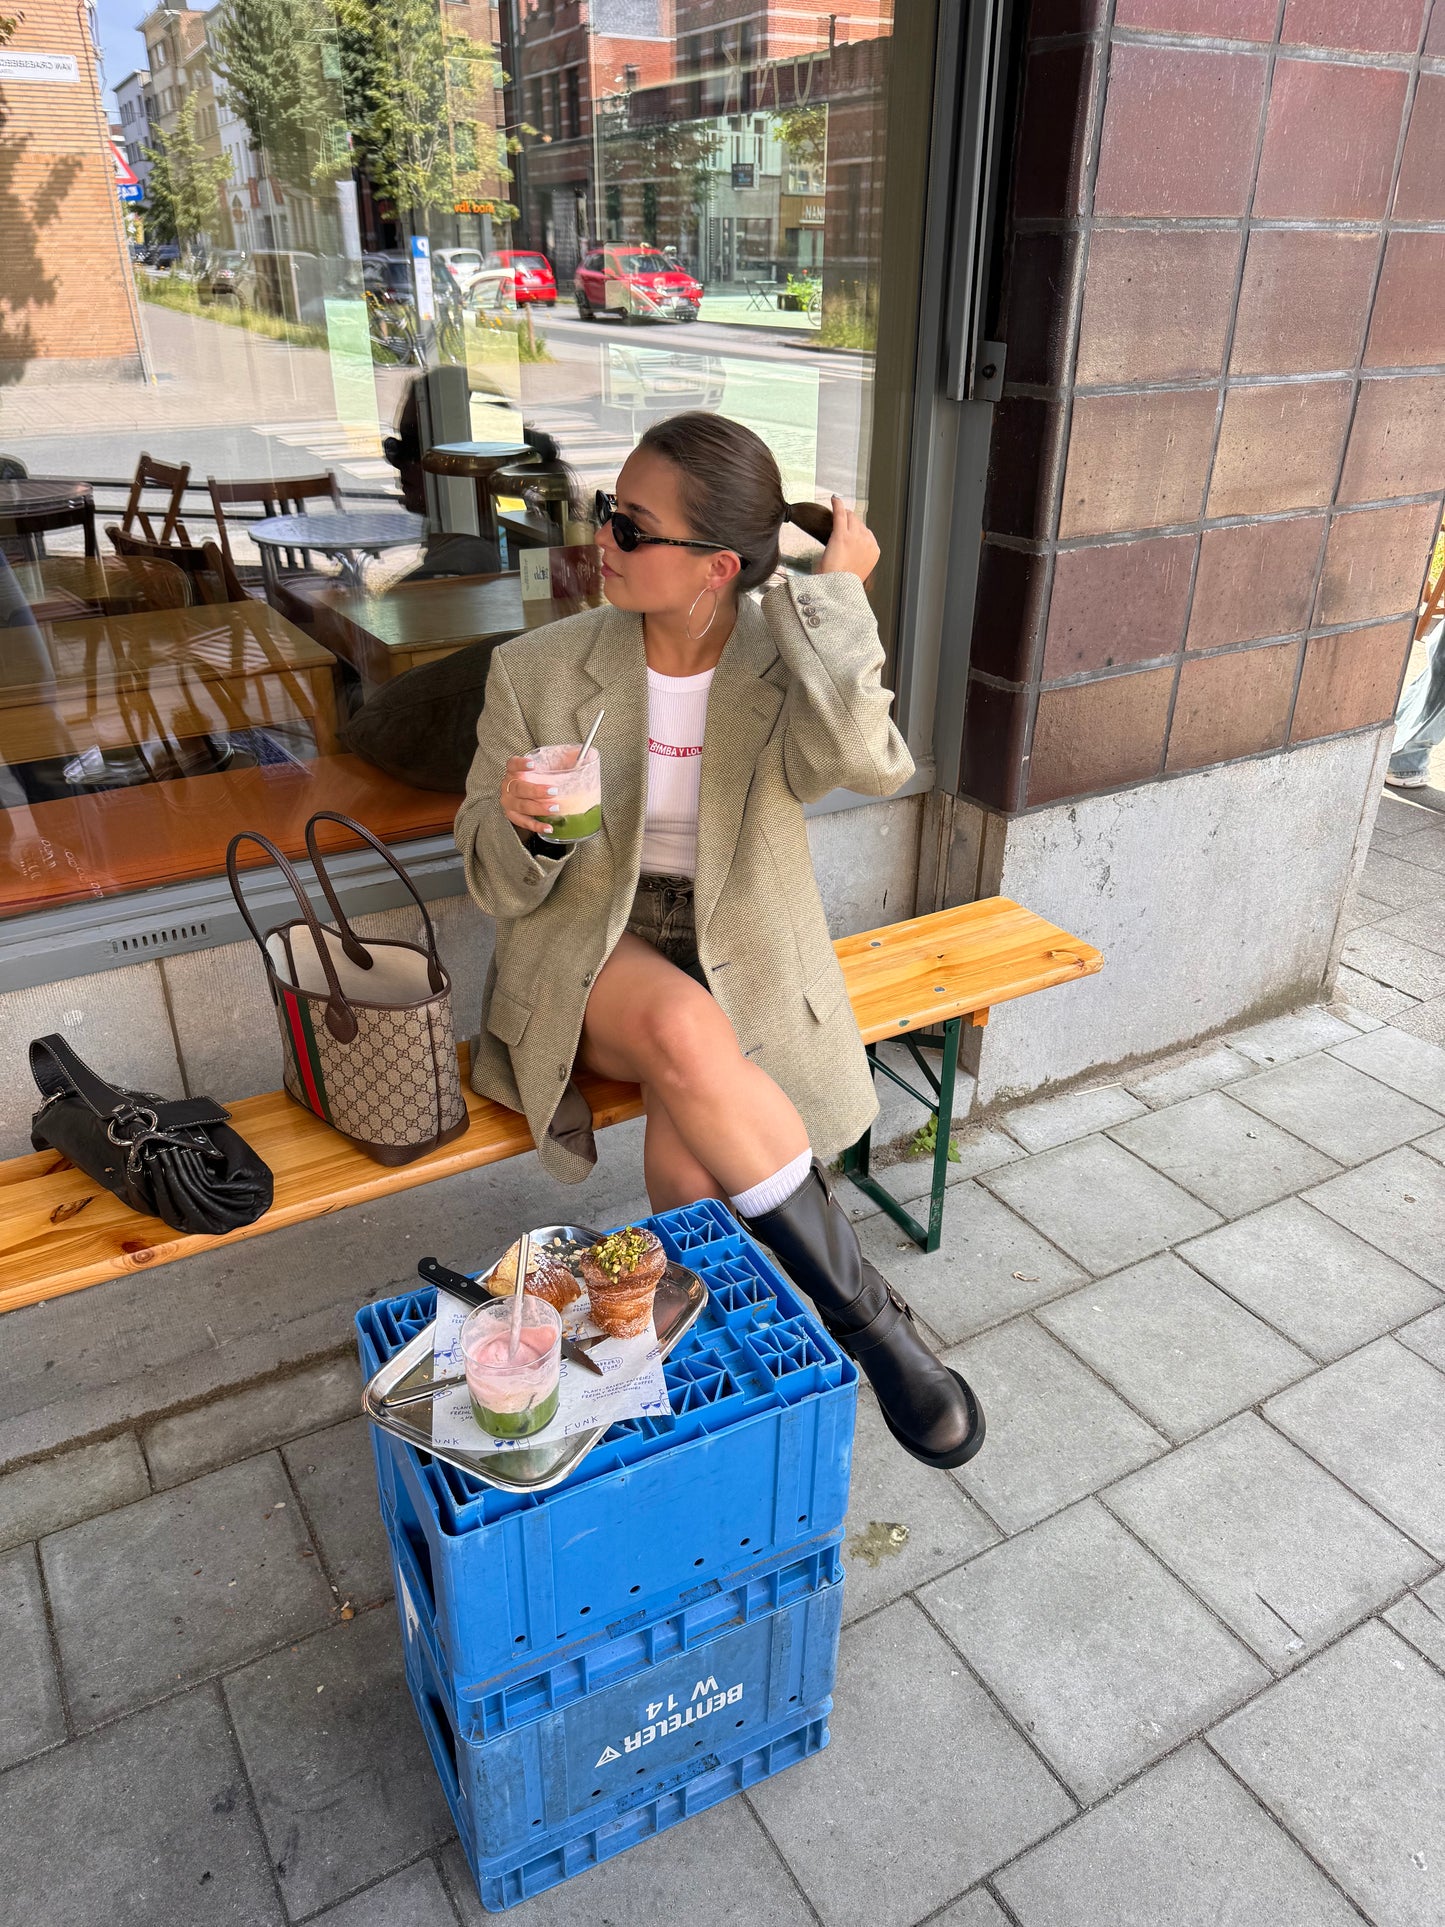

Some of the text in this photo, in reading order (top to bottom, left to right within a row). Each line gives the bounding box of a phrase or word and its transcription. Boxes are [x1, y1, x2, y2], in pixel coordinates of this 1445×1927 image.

[650, 741, 677, 757] BIMBA
[679, 748, 685, 757] Y
[563, 1414, 599, 1435] FUNK
[645, 1675, 719, 1721] W 14
[624, 1682, 744, 1754] BENTELER
